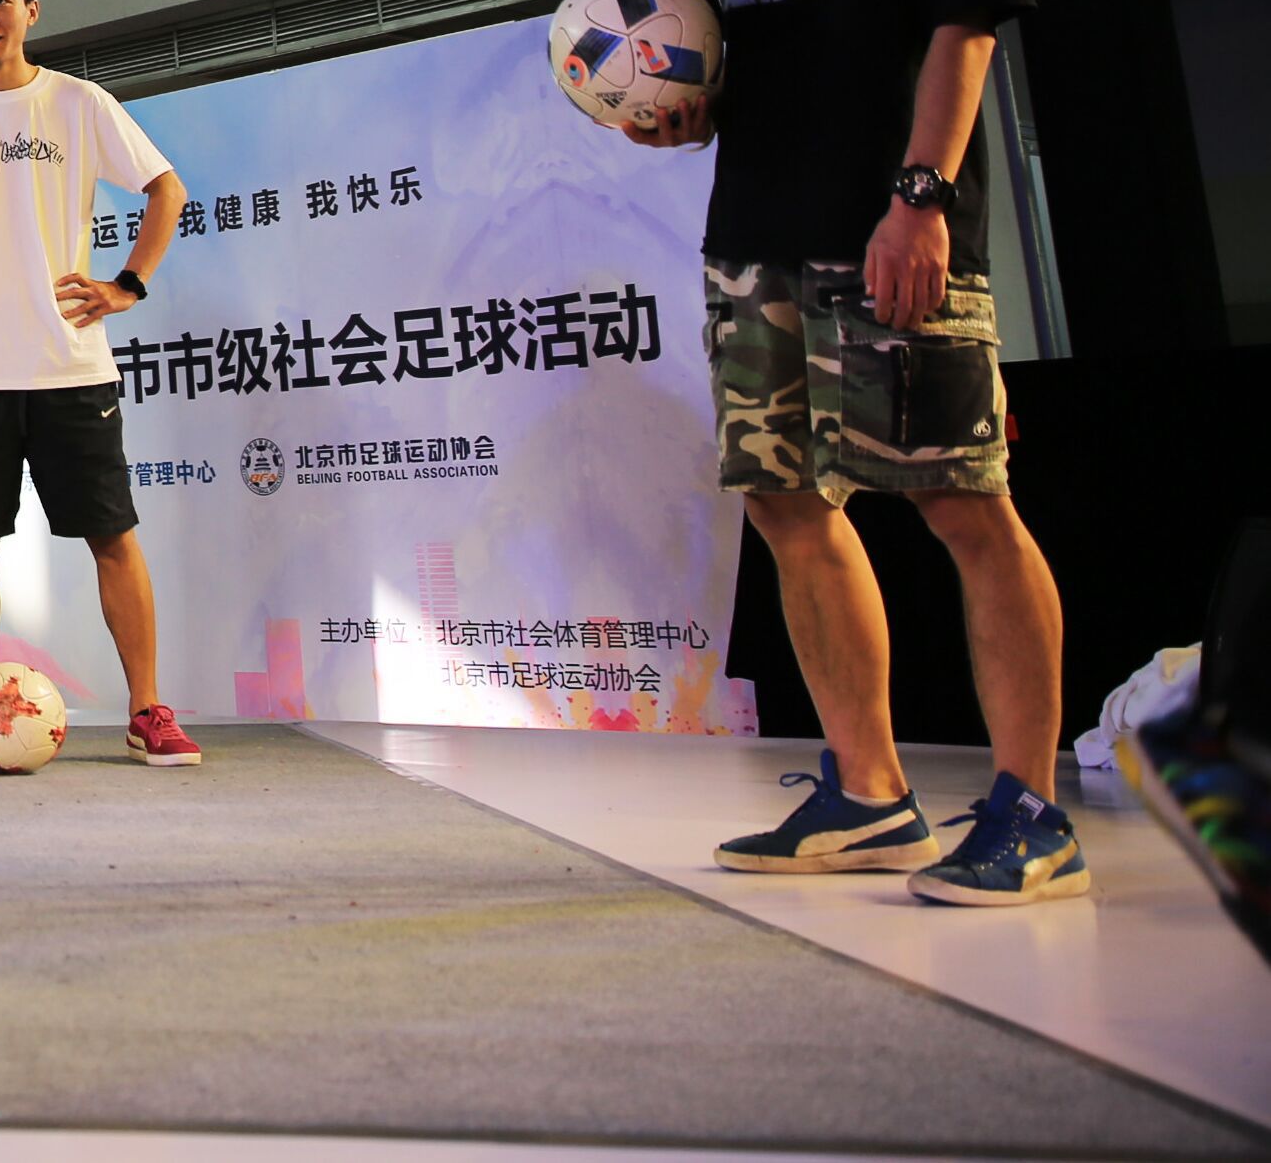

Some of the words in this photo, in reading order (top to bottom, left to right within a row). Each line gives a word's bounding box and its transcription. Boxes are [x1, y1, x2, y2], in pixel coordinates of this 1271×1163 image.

[178, 188, 281, 239] 我健康
[305, 165, 424, 220] 我快乐
[295, 435, 497, 469] 北京市足球运动协会
[297, 470, 342, 486] BEIJING
[347, 467, 409, 483] FOOTBALL
[413, 463, 499, 481] ASSOCIATION
[436, 619, 711, 651] 北京市社会体育管理中心
[440, 659, 662, 693] 北京市足球运动协会
